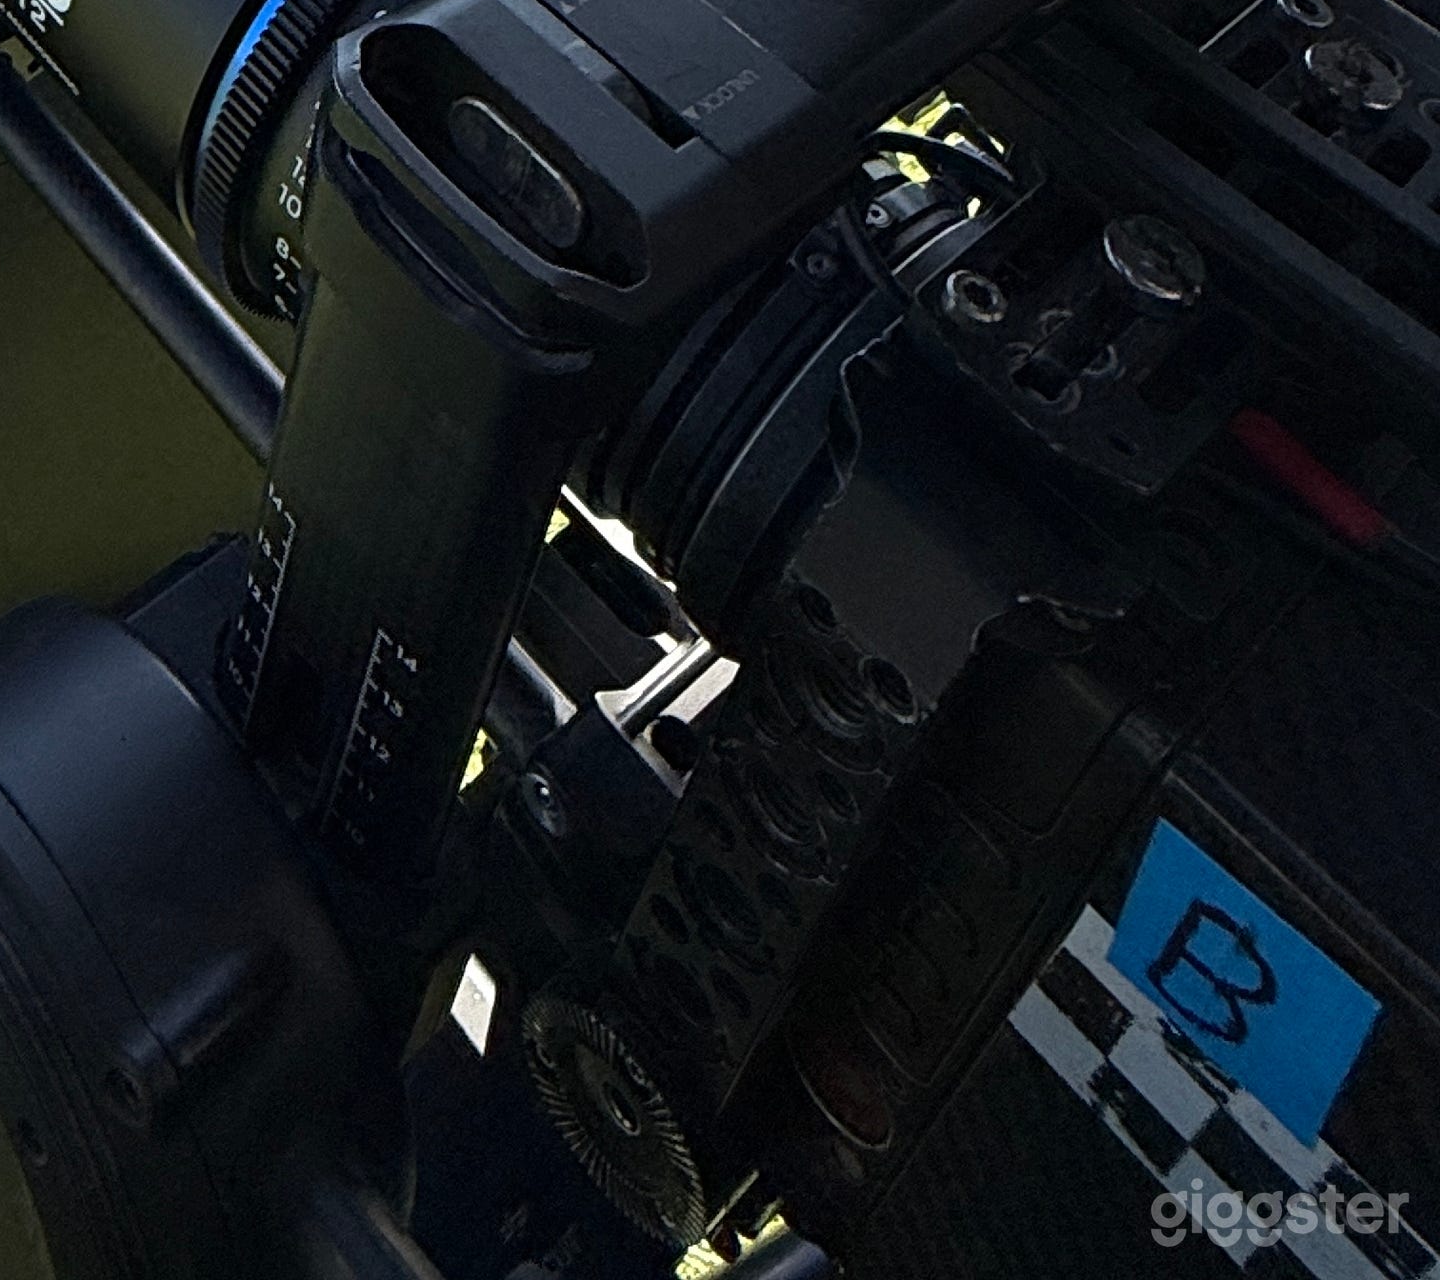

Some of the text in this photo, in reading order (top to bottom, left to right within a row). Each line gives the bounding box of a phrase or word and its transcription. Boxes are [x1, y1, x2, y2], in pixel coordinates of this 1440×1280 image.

[279, 183, 303, 220] 10
[275, 237, 290, 260] 8
[1147, 899, 1277, 1043] B
